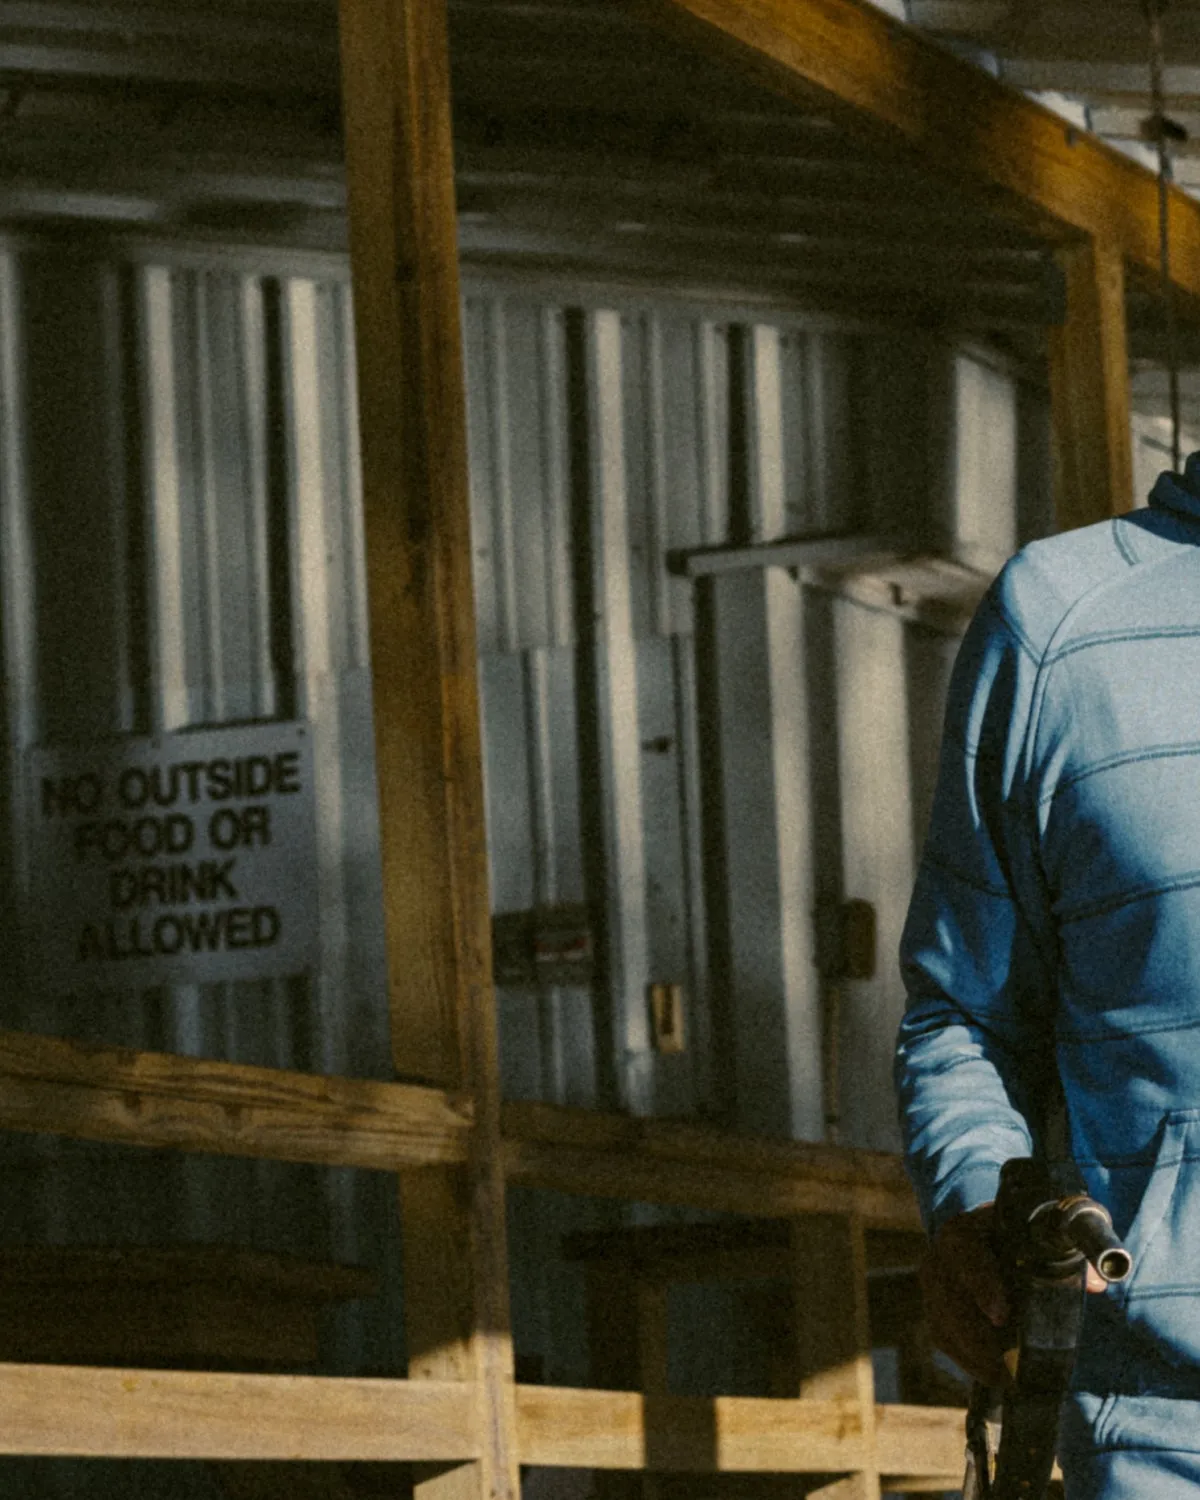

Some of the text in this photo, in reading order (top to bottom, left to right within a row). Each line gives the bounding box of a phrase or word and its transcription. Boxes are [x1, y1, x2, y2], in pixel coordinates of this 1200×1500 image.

[41, 752, 299, 815] NO OUTSIDE
[74, 806, 271, 860] FOOD OR
[108, 859, 236, 908] DRINK
[79, 906, 281, 960] ALLOWED
